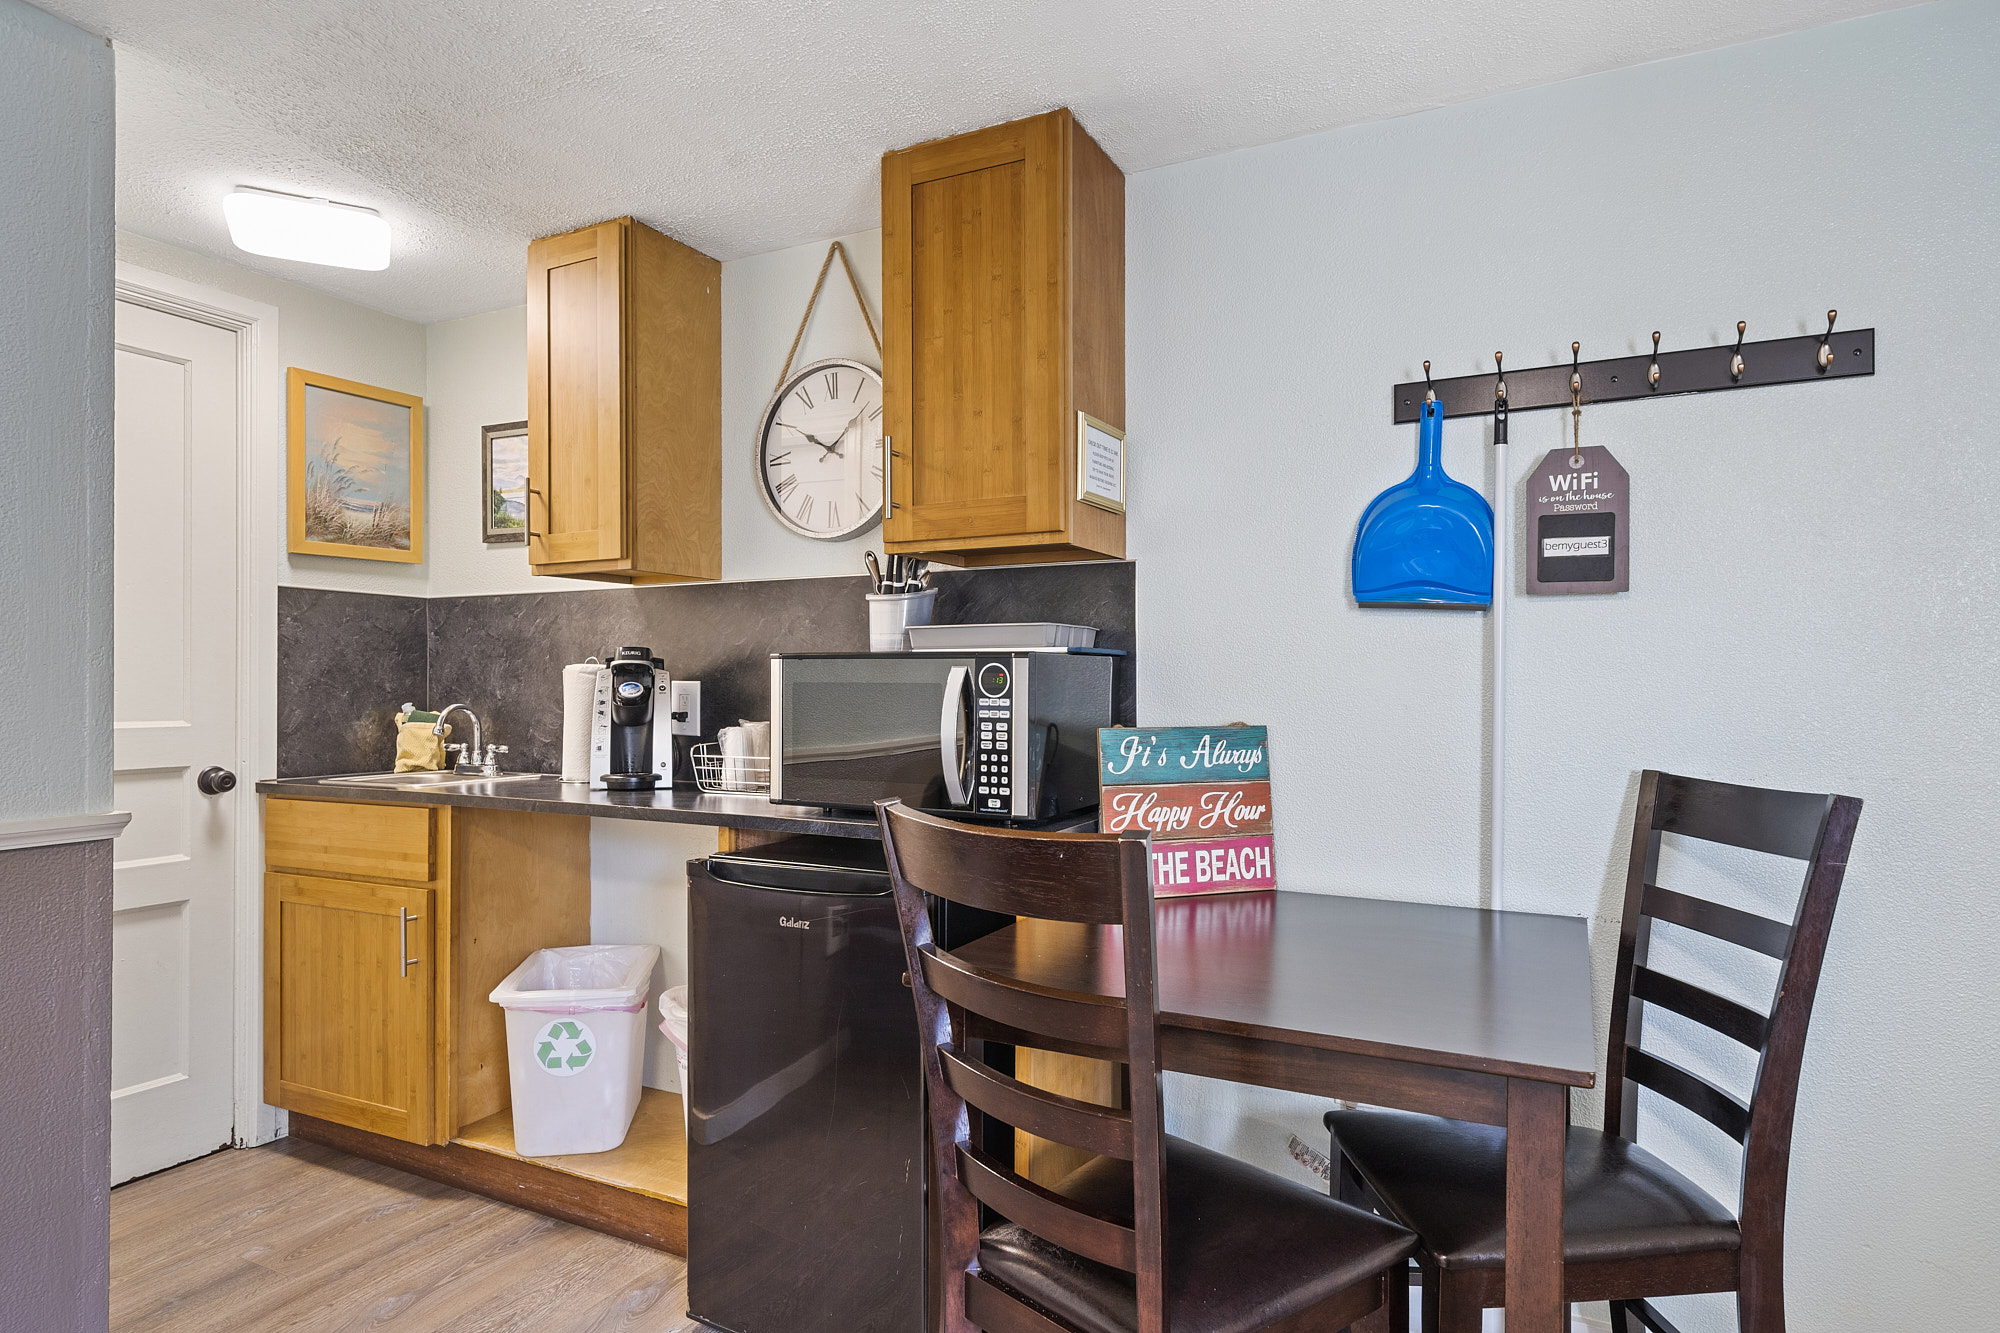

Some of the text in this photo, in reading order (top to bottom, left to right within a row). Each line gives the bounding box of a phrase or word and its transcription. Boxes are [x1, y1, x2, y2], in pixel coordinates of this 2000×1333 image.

[1548, 471, 1598, 492] WiFi
[1538, 495, 1549, 504] is
[1583, 490, 1614, 500] house
[1553, 501, 1598, 512] Password
[1544, 538, 1608, 552] bemyguest3
[1107, 734, 1263, 775] It's Always
[1110, 790, 1266, 832] Happy Hour
[1195, 846, 1271, 883] BEACH
[779, 916, 810, 929] Galanz
